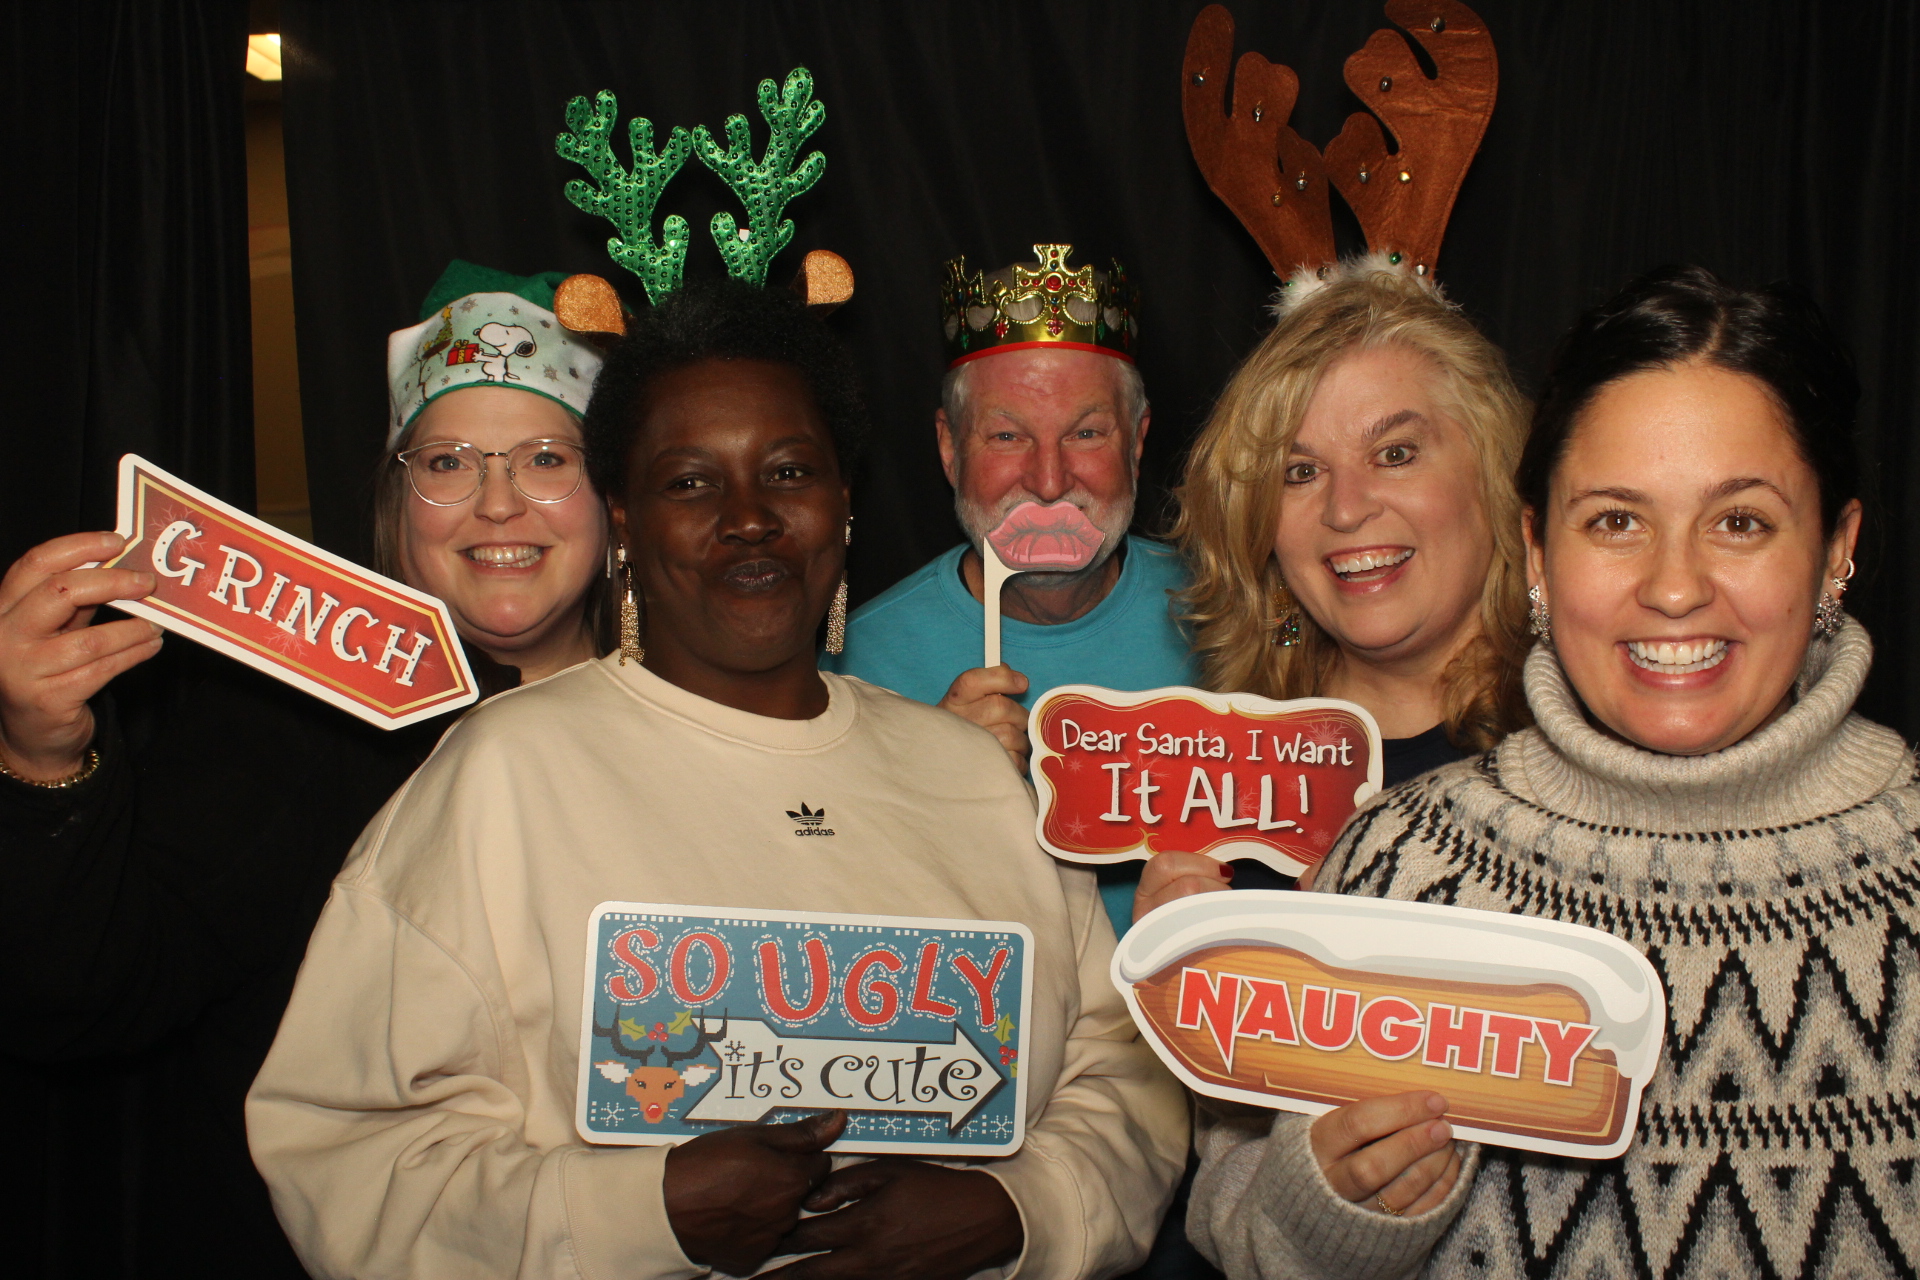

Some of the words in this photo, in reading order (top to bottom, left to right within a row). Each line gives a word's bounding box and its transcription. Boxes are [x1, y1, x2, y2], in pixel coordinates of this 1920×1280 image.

[151, 520, 432, 687] GRINCH
[1061, 719, 1127, 752] Dear
[1137, 722, 1234, 763] Santa,
[1246, 729, 1263, 761] I
[1273, 733, 1353, 766] Want
[795, 827, 835, 836] adidas
[1099, 763, 1162, 824] It
[1180, 766, 1308, 833] ALL!
[606, 926, 731, 1005] SO
[756, 935, 1010, 1029] UGLY
[1176, 966, 1600, 1086] NAUGHTY
[820, 1047, 982, 1104] cute
